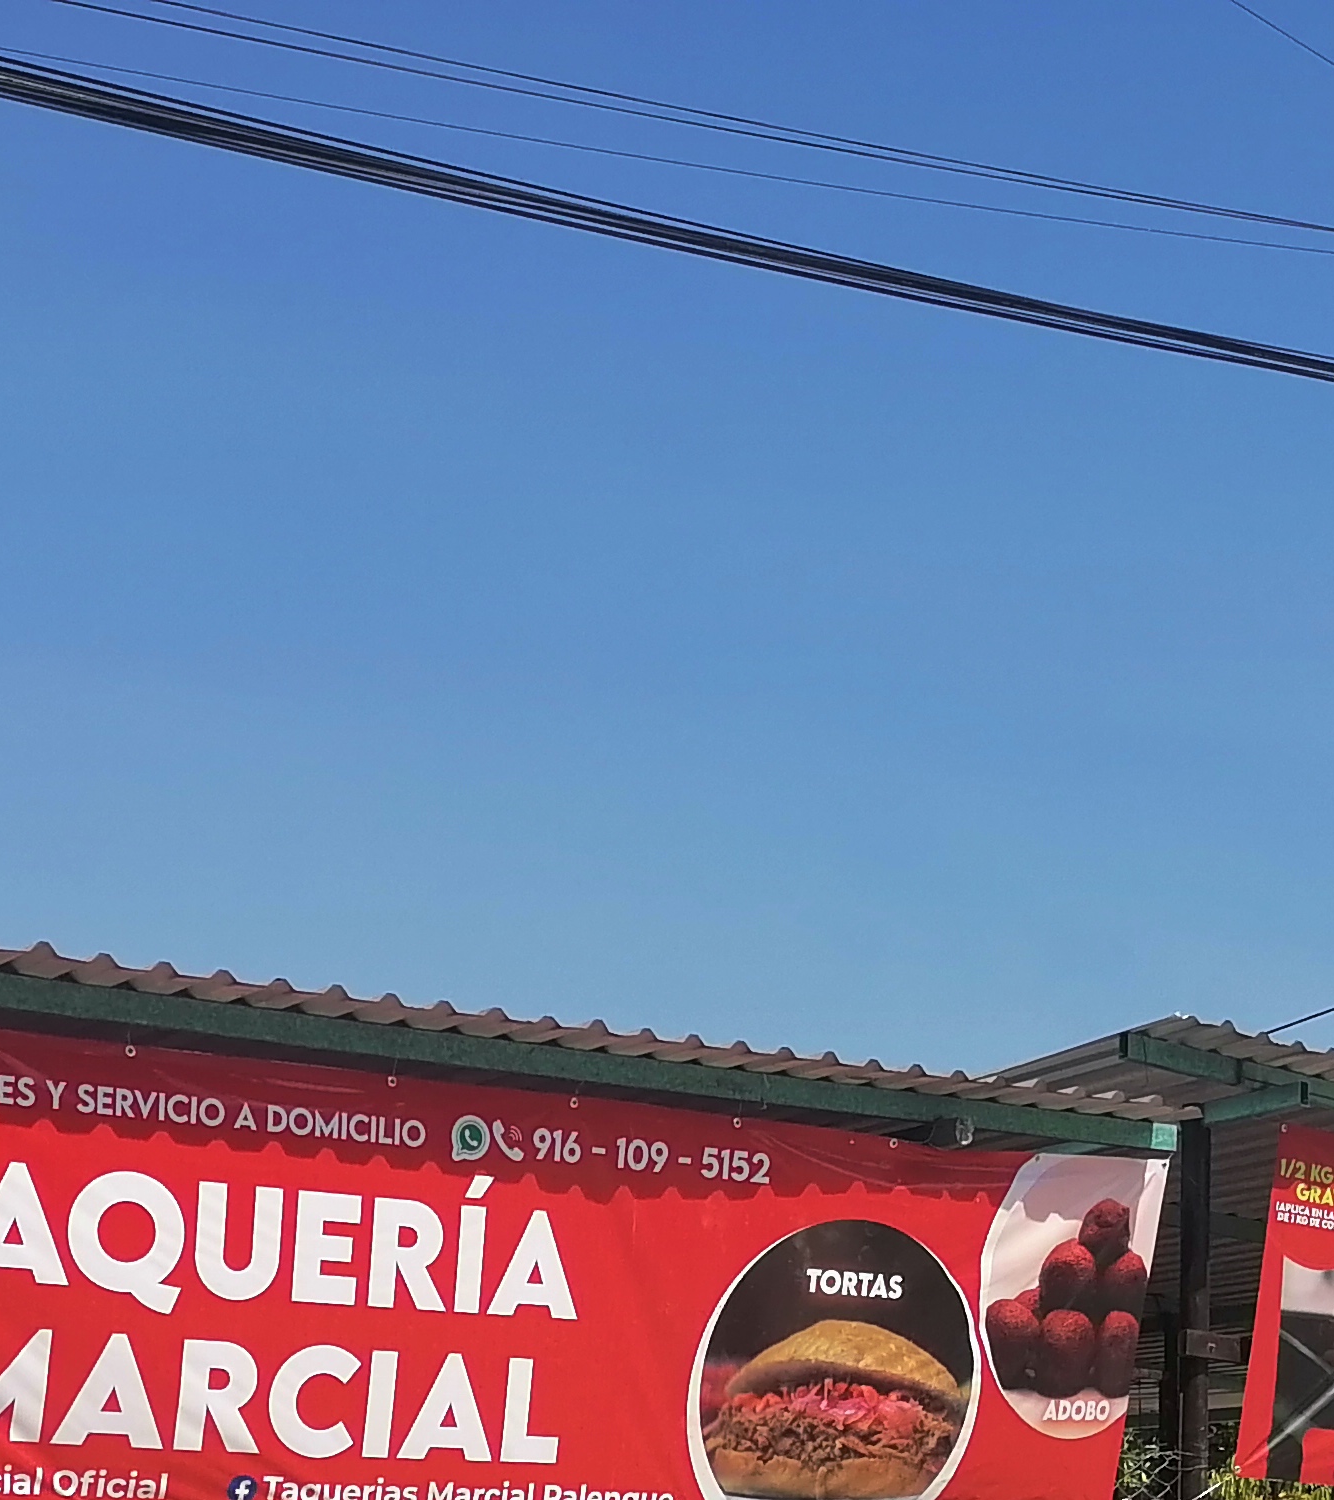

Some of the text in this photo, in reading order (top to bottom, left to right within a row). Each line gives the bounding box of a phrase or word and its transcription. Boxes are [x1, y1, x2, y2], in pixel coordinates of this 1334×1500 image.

[46, 1080, 65, 1108] Y
[77, 1084, 225, 1127] SERVICIO
[234, 1104, 257, 1131] A
[267, 1105, 425, 1148] DOMICILIO
[533, 1129, 581, 1163] 916
[617, 1139, 668, 1173] 109
[702, 1148, 770, 1184] 5152
[1280, 1158, 1306, 1179] 1/2
[1310, 1163, 1334, 1184] KG
[1312, 1208, 1323, 1218] EN
[1323, 1209, 1334, 1221] LA
[806, 1268, 903, 1300] TORTAS
[1043, 1400, 1109, 1421] ADOBO
[53, 1470, 168, 1500] Oficial
